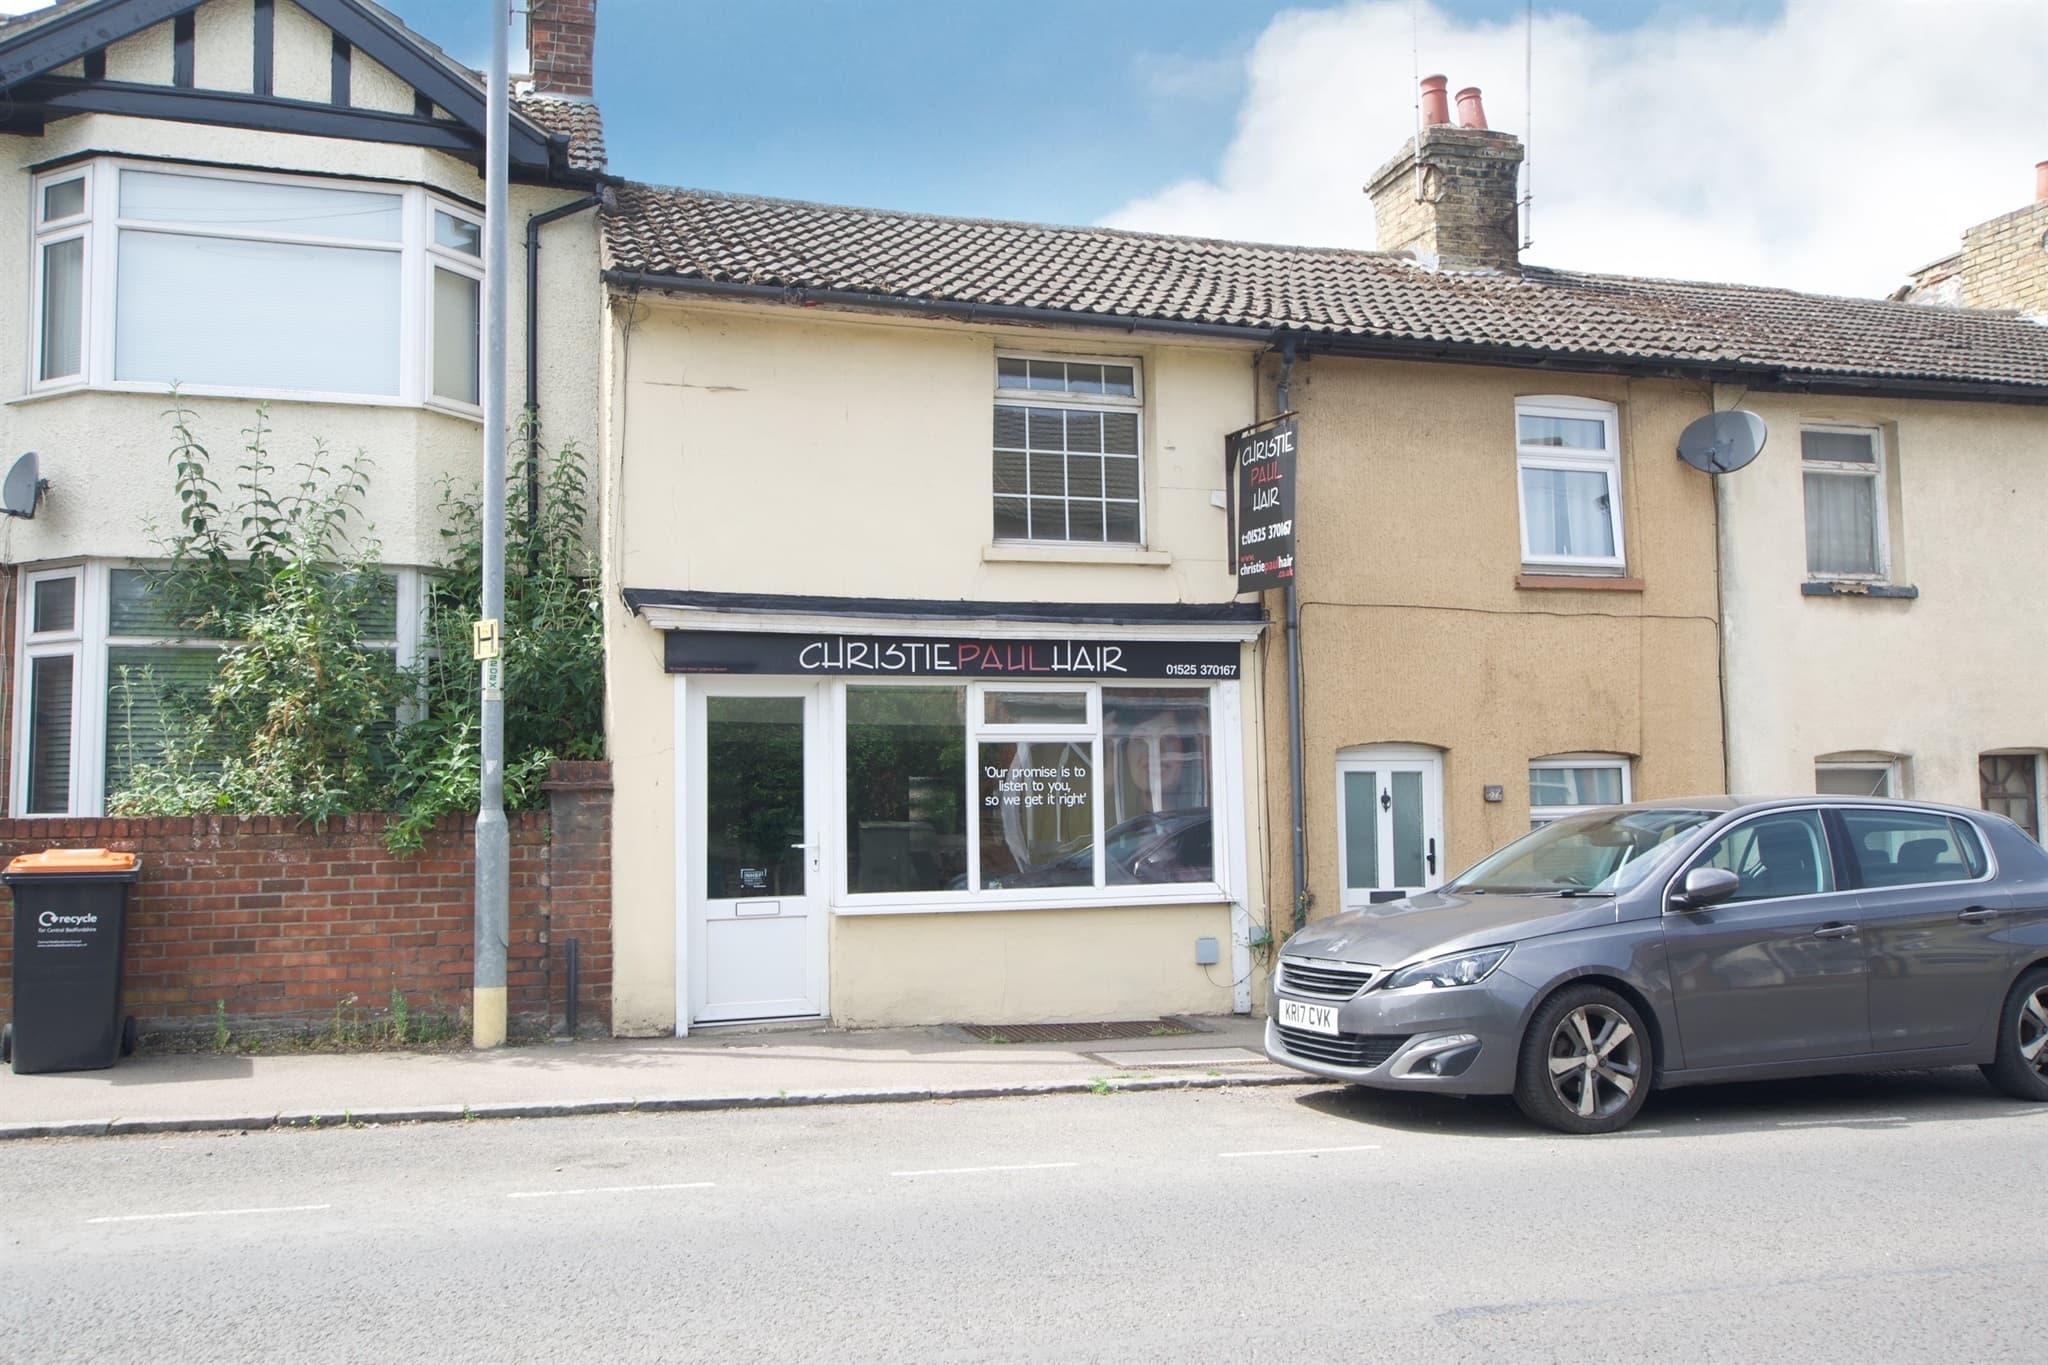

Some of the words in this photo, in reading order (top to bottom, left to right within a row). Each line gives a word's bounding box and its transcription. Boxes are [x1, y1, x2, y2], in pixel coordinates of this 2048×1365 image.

[1241, 431, 1294, 466] CHRISTIE
[1251, 461, 1283, 487] PAUL
[1253, 487, 1280, 512] HAIR
[799, 636, 958, 673] CHRISTIE
[958, 644, 1050, 671] PAUL
[1051, 640, 1128, 673] HAIR
[1166, 664, 1197, 675] 01525
[1200, 664, 1237, 676] 370167
[1012, 766, 1057, 779] promise
[1061, 766, 1070, 777] is
[1074, 766, 1086, 777] to
[999, 780, 1028, 792] listen
[1032, 781, 1044, 792] to
[1048, 782, 1071, 793] you,
[985, 796, 999, 806] so
[1003, 796, 1020, 806] we
[1024, 794, 1043, 807] get
[1047, 793, 1055, 804] it
[59, 912, 98, 926] recycle
[1285, 1002, 1306, 1023] KR17
[1308, 1006, 1331, 1028] CVK
